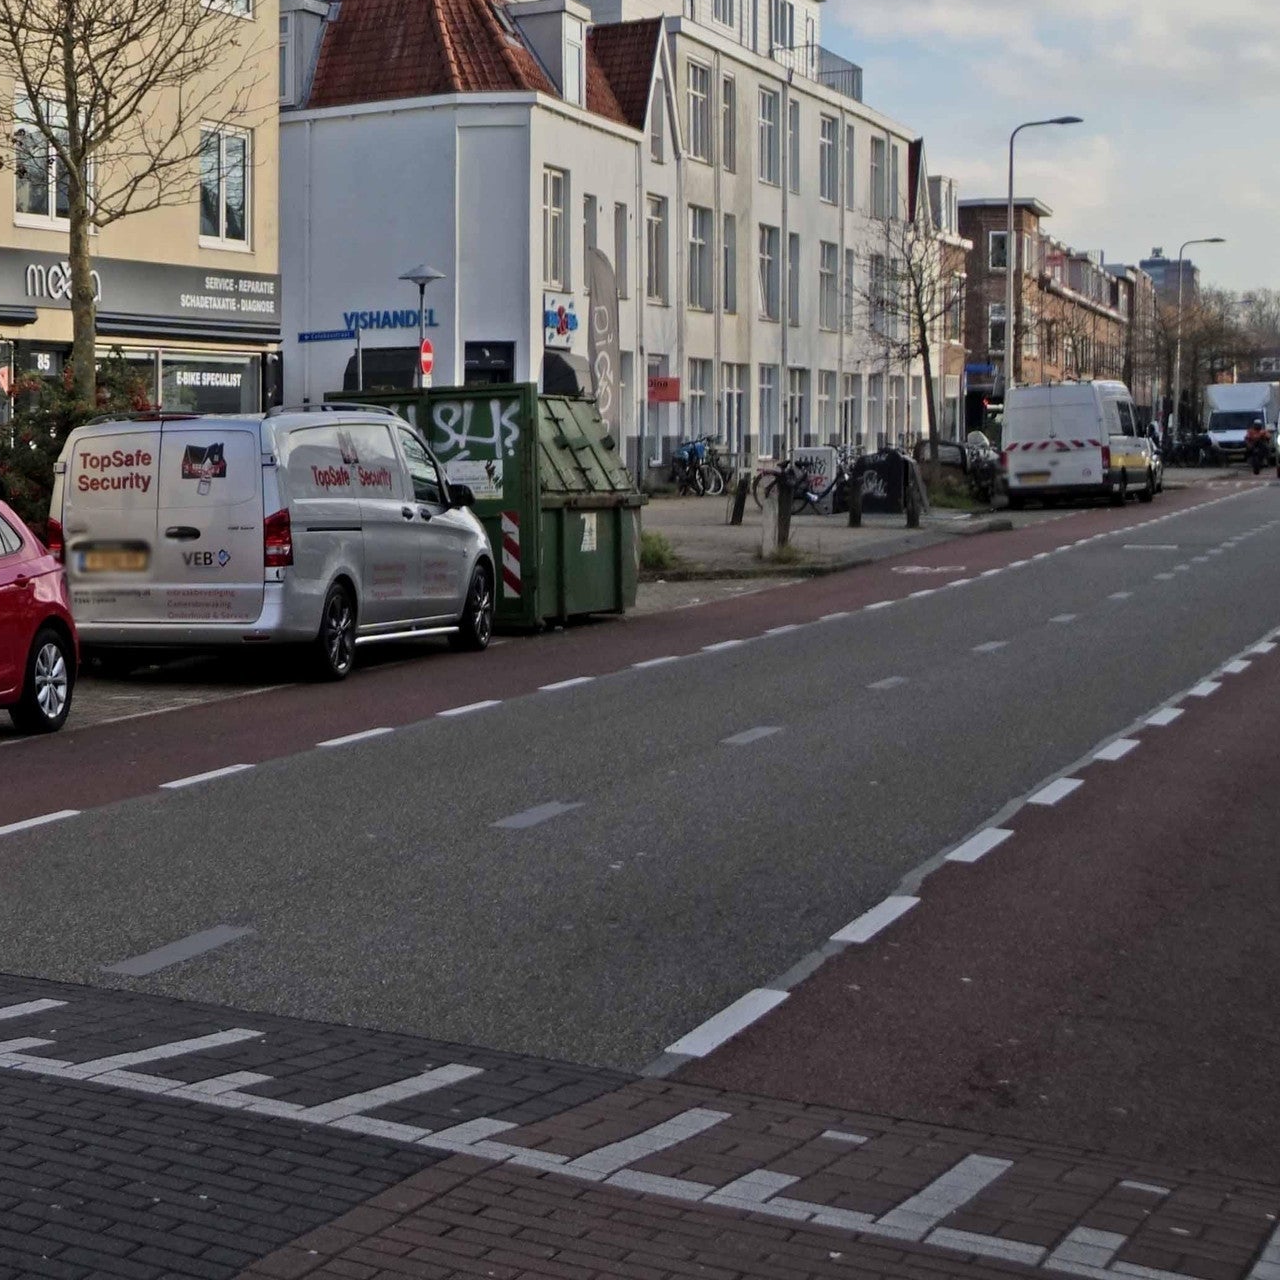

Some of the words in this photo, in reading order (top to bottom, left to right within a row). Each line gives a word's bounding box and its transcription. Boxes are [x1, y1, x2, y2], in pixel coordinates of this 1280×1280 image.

[205, 276, 234, 291] SERVICE
[238, 279, 275, 295] REPARATIE
[180, 294, 236, 311] SCHADETAXATIE
[240, 299, 275, 313] DIAGNOSE
[343, 308, 439, 331] VISHANDEL
[37, 354, 51, 370] 85
[176, 371, 201, 386] E-BIKE
[202, 372, 242, 388] SPECIALIST
[80, 450, 152, 472] TopSafe
[78, 473, 151, 493] Security
[311, 465, 351, 490] TopSafe
[357, 466, 392, 490] Security
[182, 551, 213, 566] VEB
